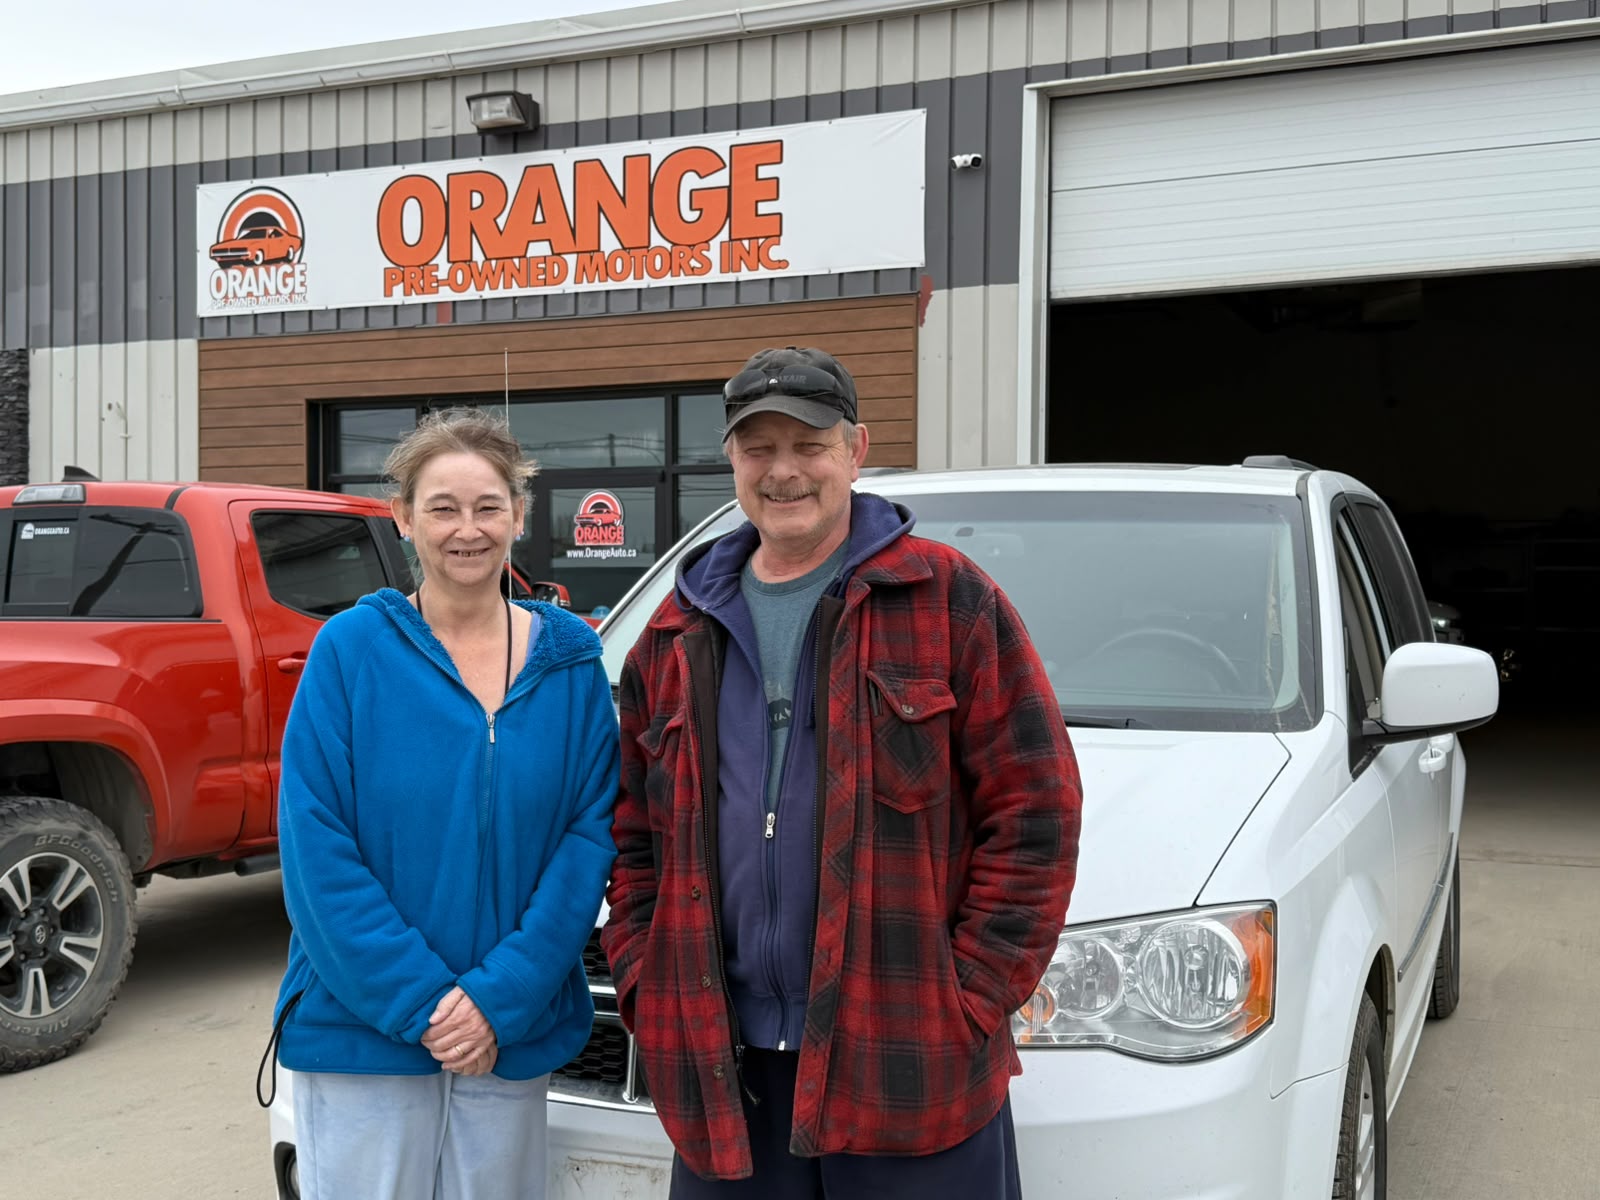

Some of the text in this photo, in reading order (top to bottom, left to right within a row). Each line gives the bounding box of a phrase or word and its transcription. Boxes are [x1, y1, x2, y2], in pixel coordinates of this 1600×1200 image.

[377, 140, 783, 268] ORANGE
[383, 236, 789, 298] PRE-OWNED MOTORS INC.
[210, 263, 307, 300] ORANGE
[259, 294, 291, 306] MOTORS
[575, 525, 624, 541] ORANGE
[566, 547, 636, 559] www.OrangeAuto.ca
